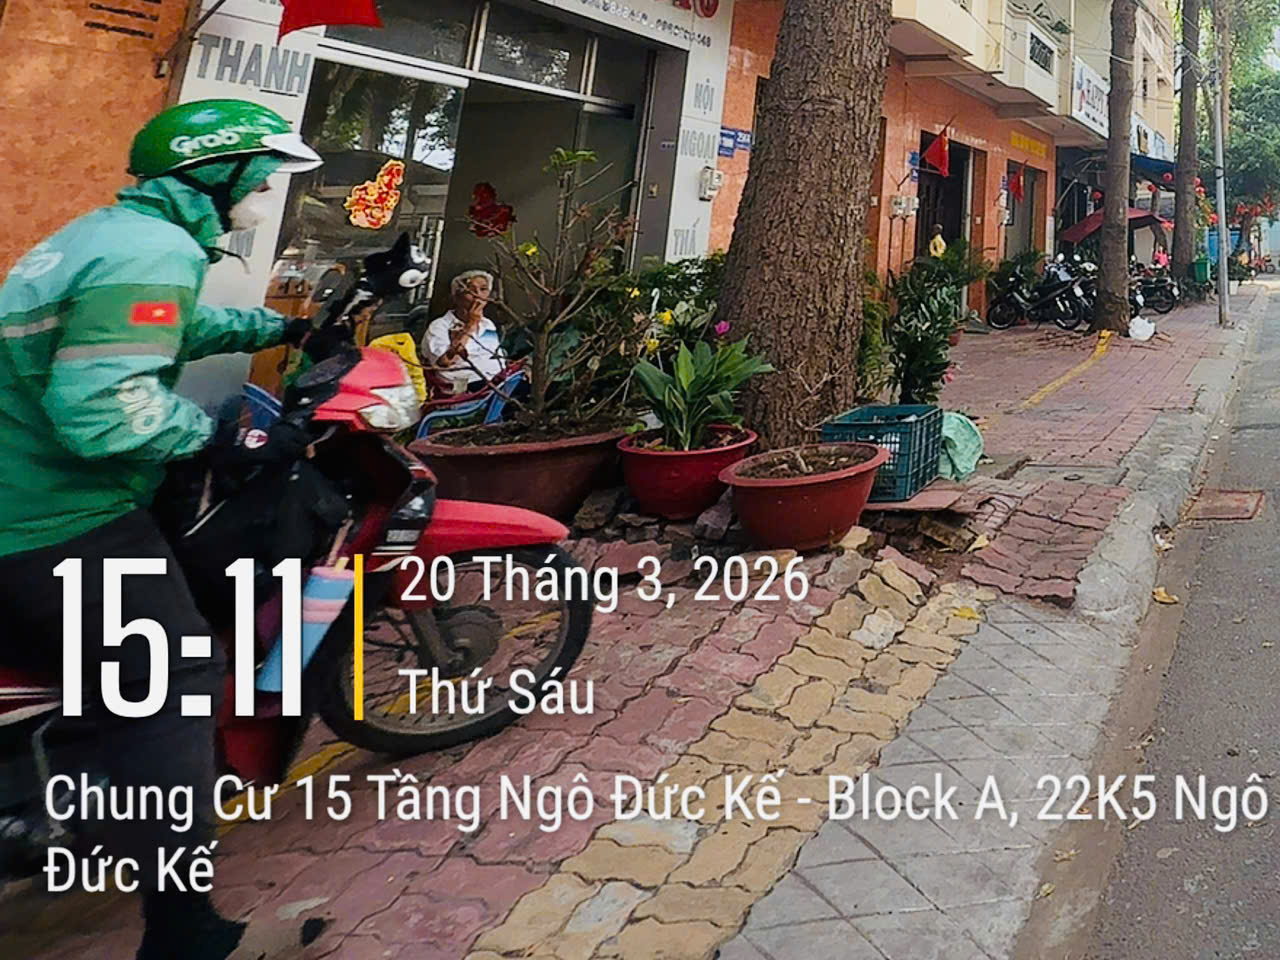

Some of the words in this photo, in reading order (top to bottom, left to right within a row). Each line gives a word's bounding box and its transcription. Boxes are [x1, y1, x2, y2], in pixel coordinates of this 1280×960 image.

[197, 33, 311, 93] THANH
[694, 78, 714, 115] NỘI
[169, 129, 241, 156] Grab
[680, 129, 716, 164] NGOẠI
